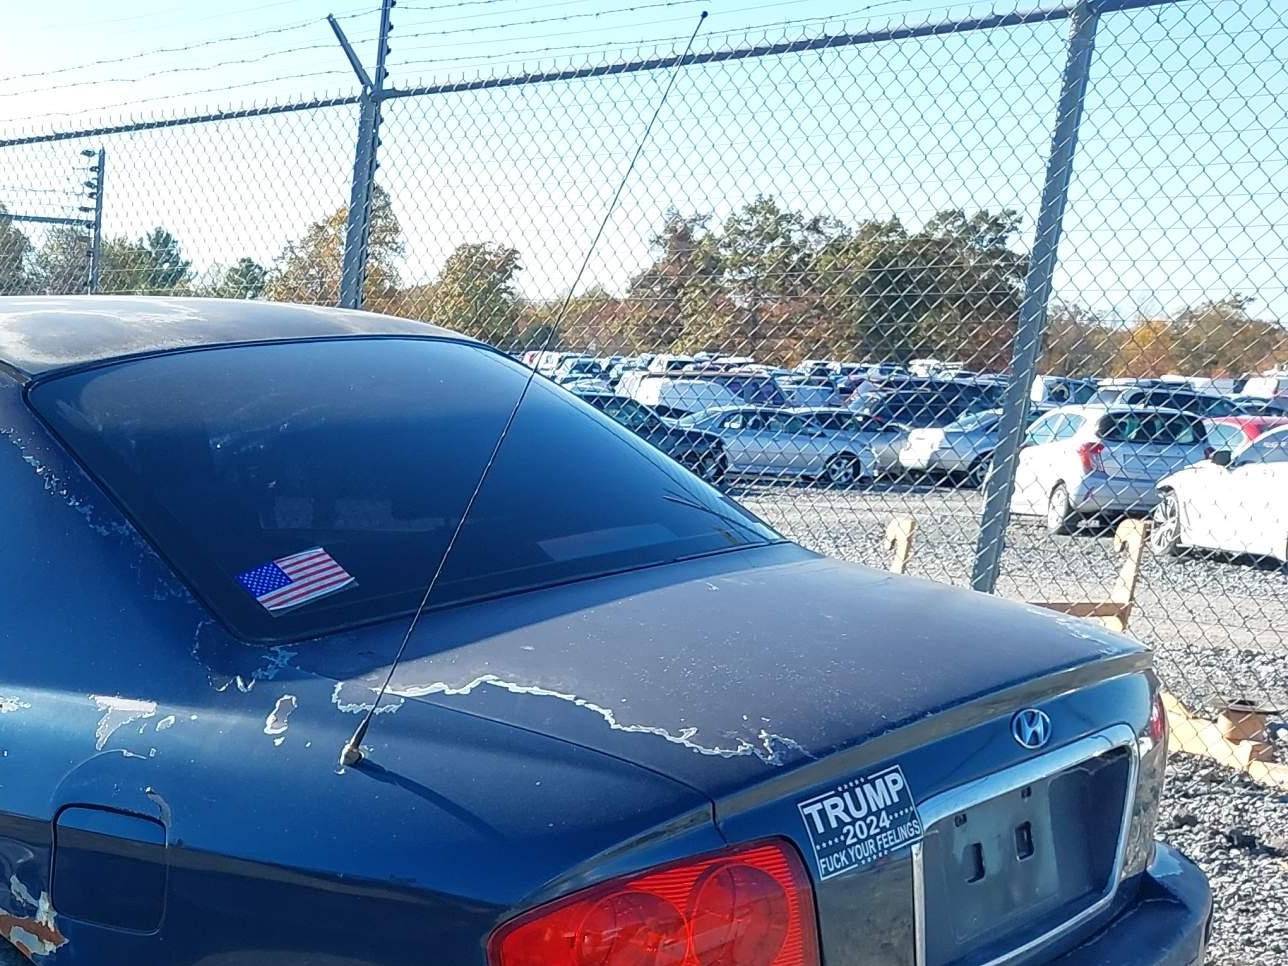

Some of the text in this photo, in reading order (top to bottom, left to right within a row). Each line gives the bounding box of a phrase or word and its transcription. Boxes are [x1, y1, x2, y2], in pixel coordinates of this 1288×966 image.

[803, 772, 904, 834] TRUMP
[842, 810, 891, 846] 2024
[819, 819, 921, 875] FUCK YOUR FEELINGS
